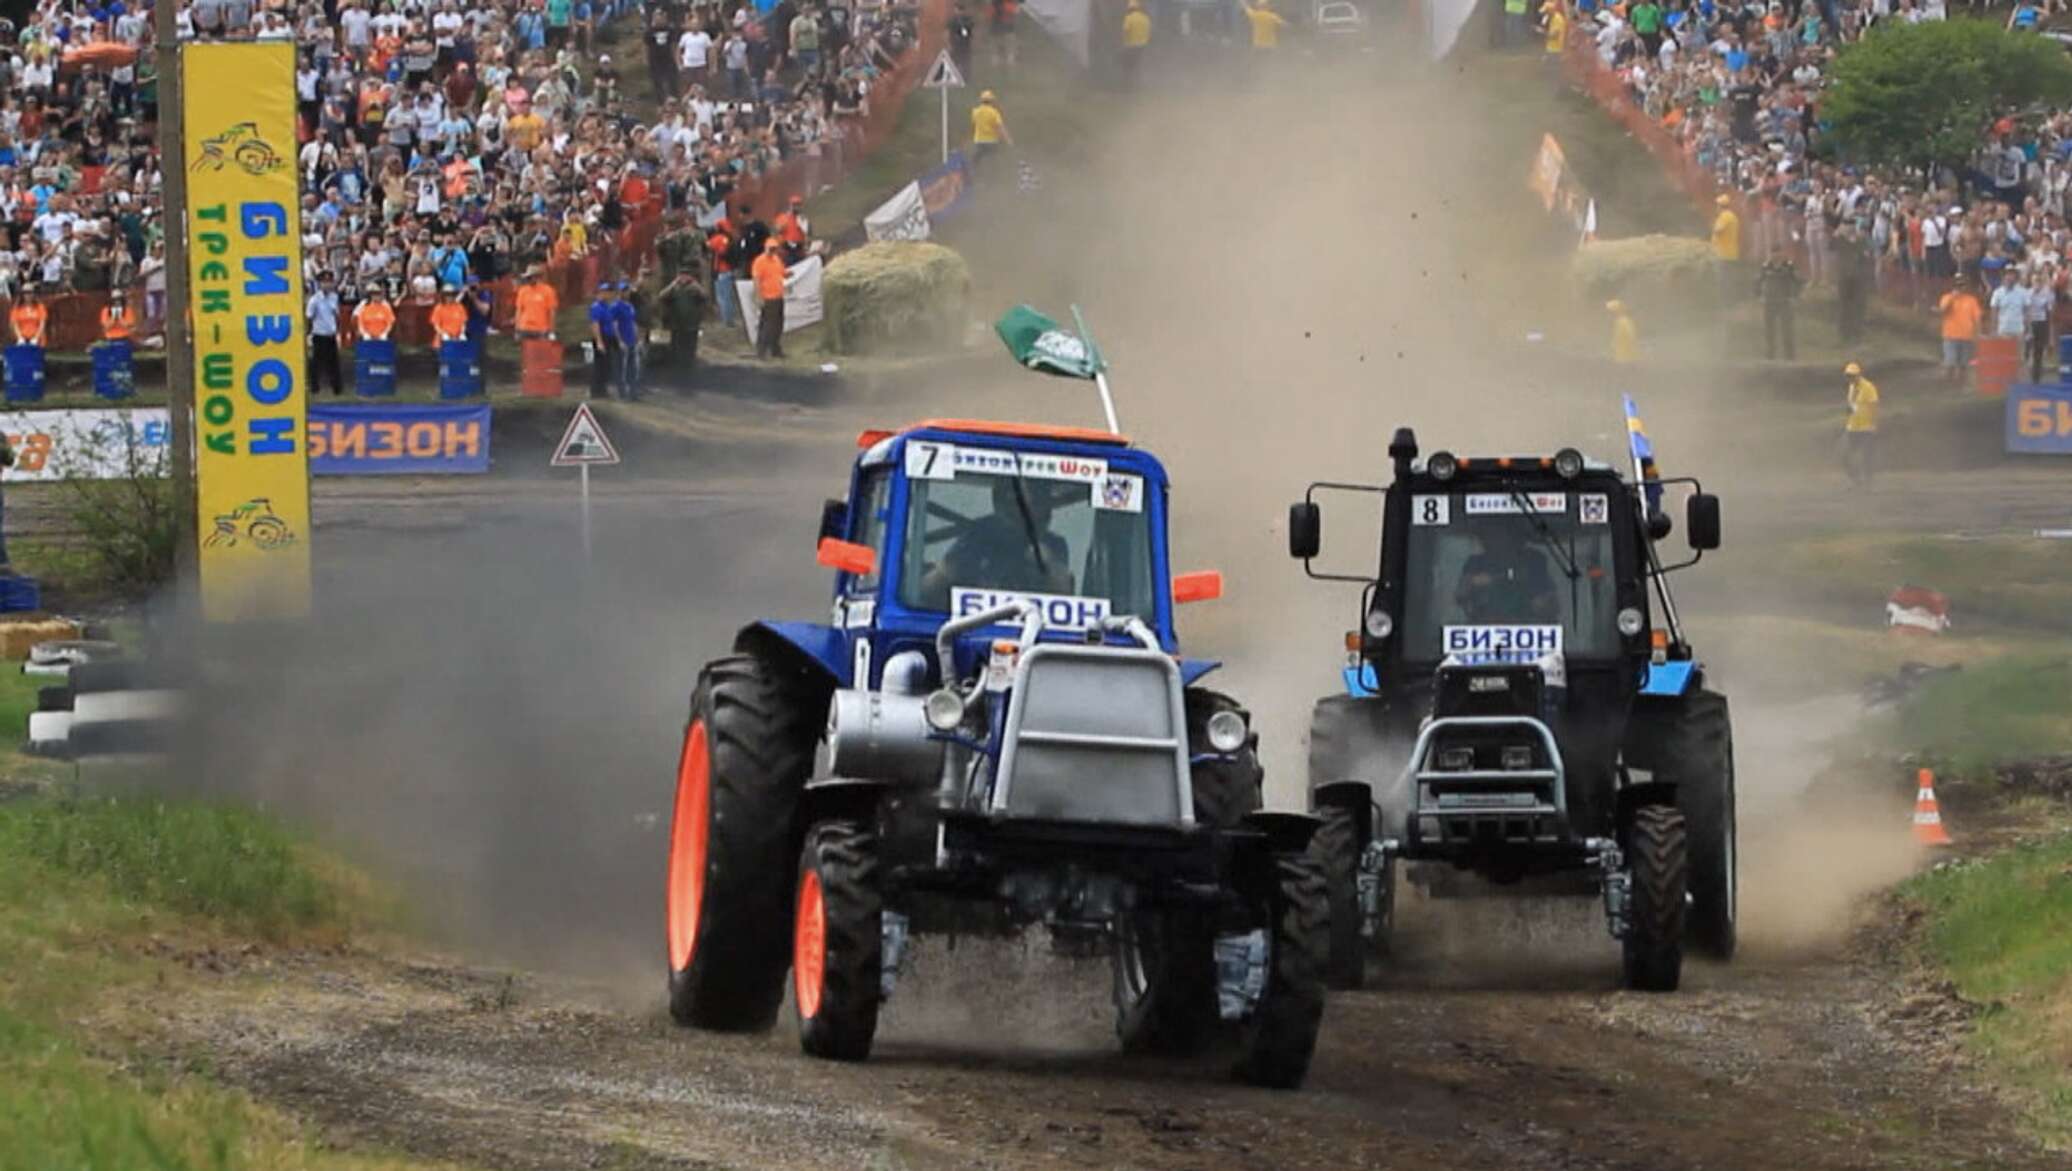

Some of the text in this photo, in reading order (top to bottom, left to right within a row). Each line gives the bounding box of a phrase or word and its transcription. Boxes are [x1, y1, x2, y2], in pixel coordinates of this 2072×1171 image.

[197, 204, 236, 455] ТРЕК-ШОУ
[239, 202, 296, 455] БИЗОН
[308, 421, 480, 458] БИЗОН
[920, 445, 939, 475] 7
[1423, 498, 1438, 523] 8
[960, 593, 1102, 626] БОН
[1451, 628, 1556, 649] БИЗОН
